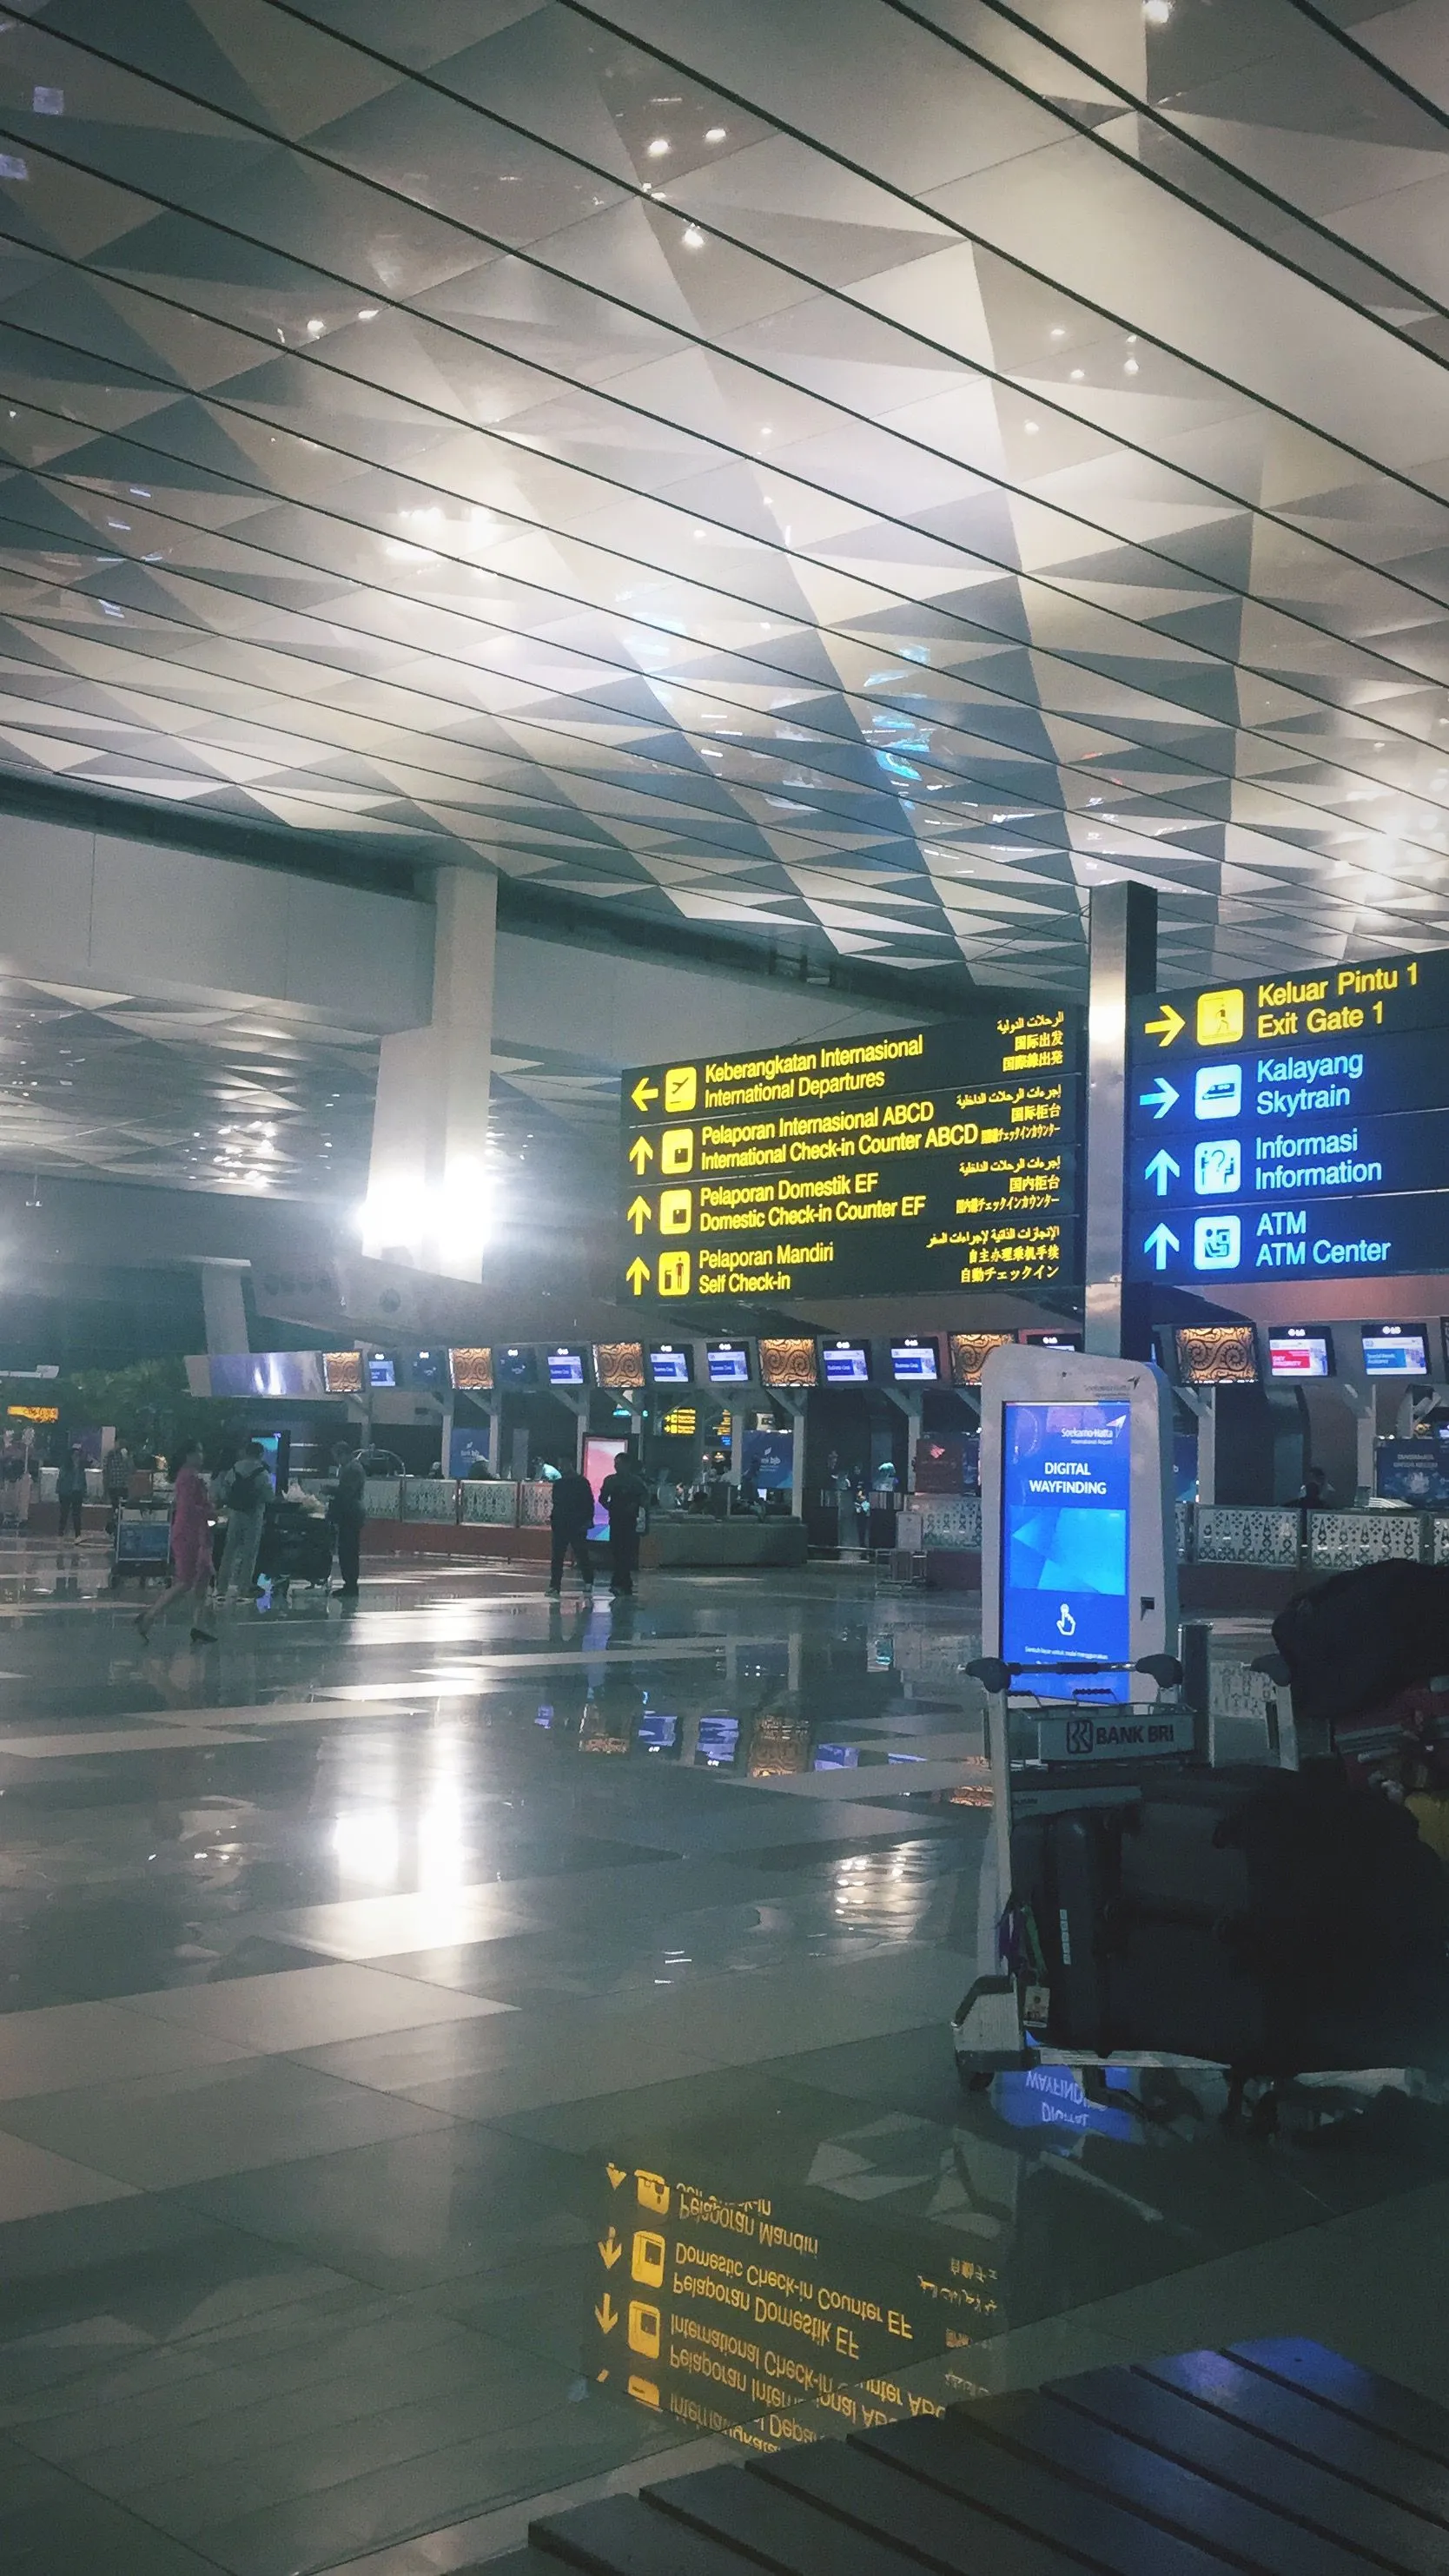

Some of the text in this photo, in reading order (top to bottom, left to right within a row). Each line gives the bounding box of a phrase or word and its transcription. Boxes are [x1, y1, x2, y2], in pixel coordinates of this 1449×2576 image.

[1258, 962, 1419, 1008] Keluar Pintu 1
[1258, 1001, 1384, 1039] Exit Gate 1
[1015, 1030, 1063, 1052] 国际出发
[705, 1034, 923, 1083] Keberangkatan Internasional
[1257, 1054, 1364, 1085] Kalayang
[705, 1070, 885, 1108] International Departures
[1256, 1084, 1351, 1118] Skytrain
[702, 1101, 934, 1146] Pelaporan Internasional ABCD
[701, 1123, 979, 1171] International Check-in Counter ABCD
[1255, 1128, 1359, 1160] Informasi
[1009, 1174, 1061, 1193] 国内柜台
[1255, 1159, 1382, 1190] Information
[699, 1172, 879, 1209] Pelaporan Domestik EF
[699, 1195, 927, 1232] Domestic Check-in Counter EF
[1256, 1210, 1307, 1236] ATM
[698, 1242, 834, 1271] Pelaporan Mandiri
[1256, 1238, 1392, 1267] ATM Center
[698, 1271, 791, 1294] Self Check-in
[1044, 1462, 1091, 1476] DIGITAL
[1029, 1479, 1107, 1495] WAYFINDING
[1095, 1724, 1174, 1745] BANK BRI
